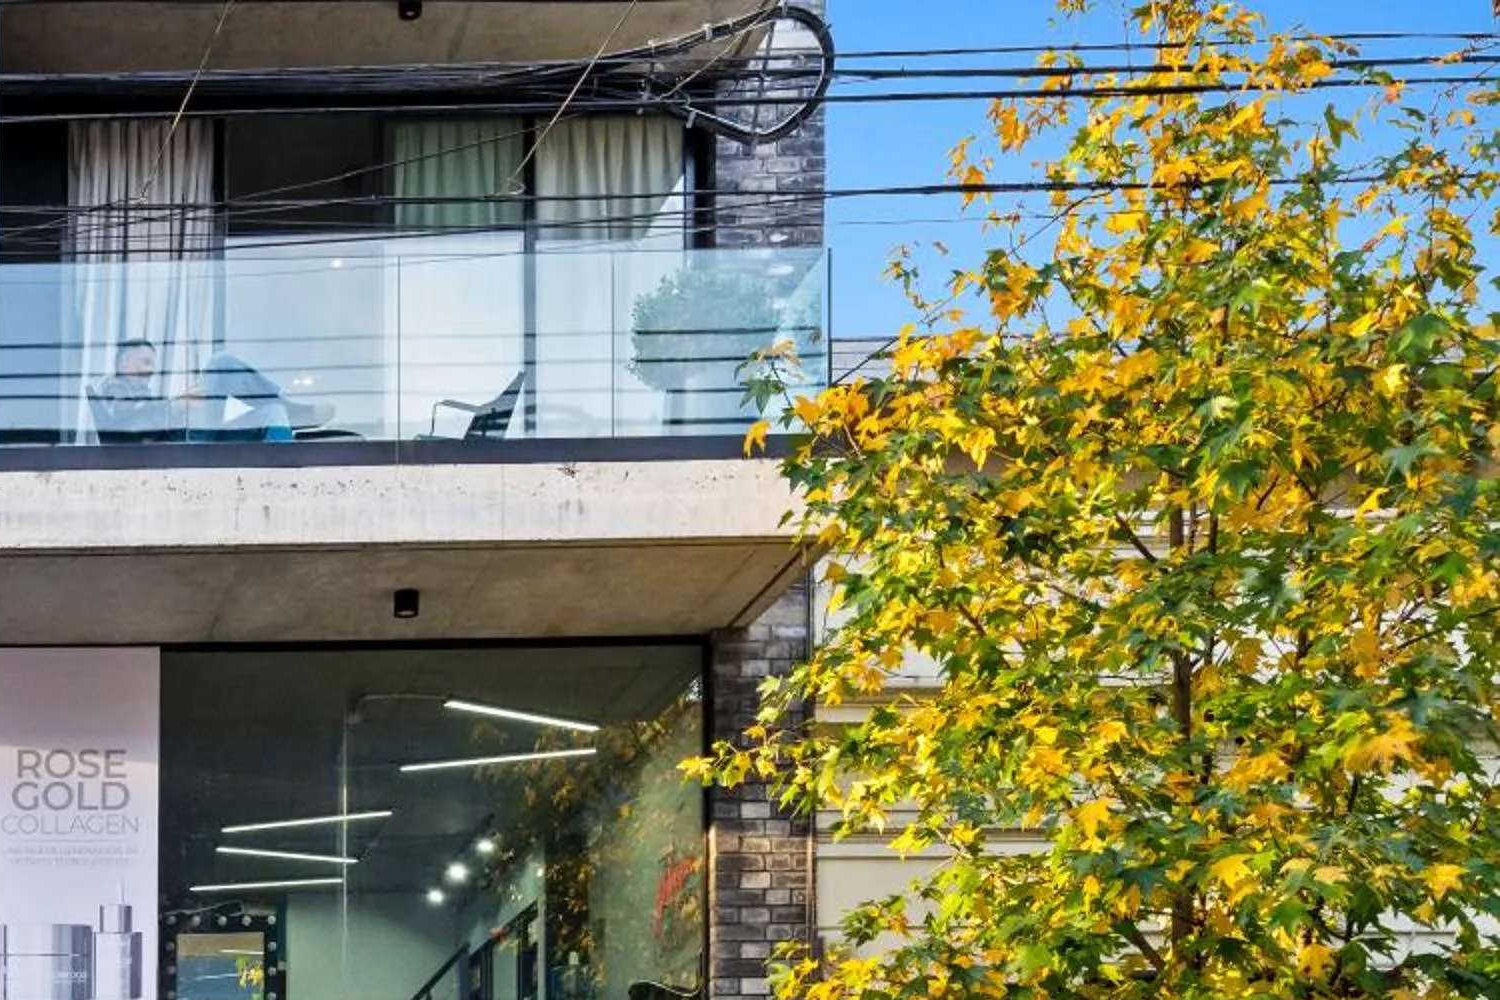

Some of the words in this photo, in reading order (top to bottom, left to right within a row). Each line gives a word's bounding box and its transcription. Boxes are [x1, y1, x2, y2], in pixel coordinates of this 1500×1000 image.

[16, 748, 128, 779] ROSE
[11, 781, 131, 812] GOLD
[0, 813, 140, 836] COLLAGEN
